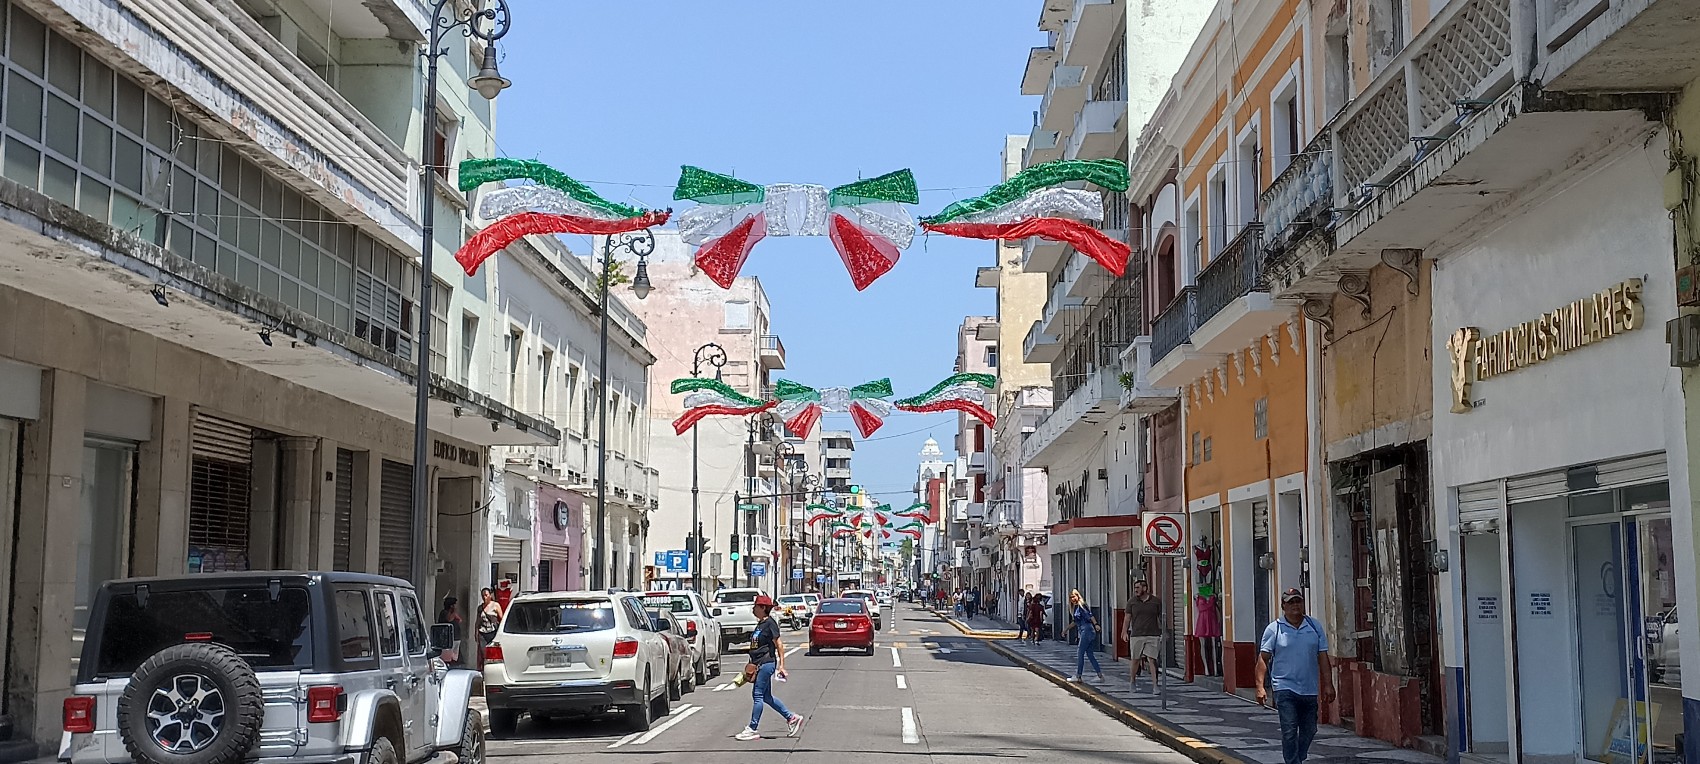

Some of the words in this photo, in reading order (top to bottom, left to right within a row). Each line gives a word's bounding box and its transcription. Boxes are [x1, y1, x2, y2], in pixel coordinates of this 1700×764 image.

[1475, 311, 1549, 381] FARMACIAS
[1550, 278, 1643, 356] SIMILARES
[673, 556, 682, 567] P
